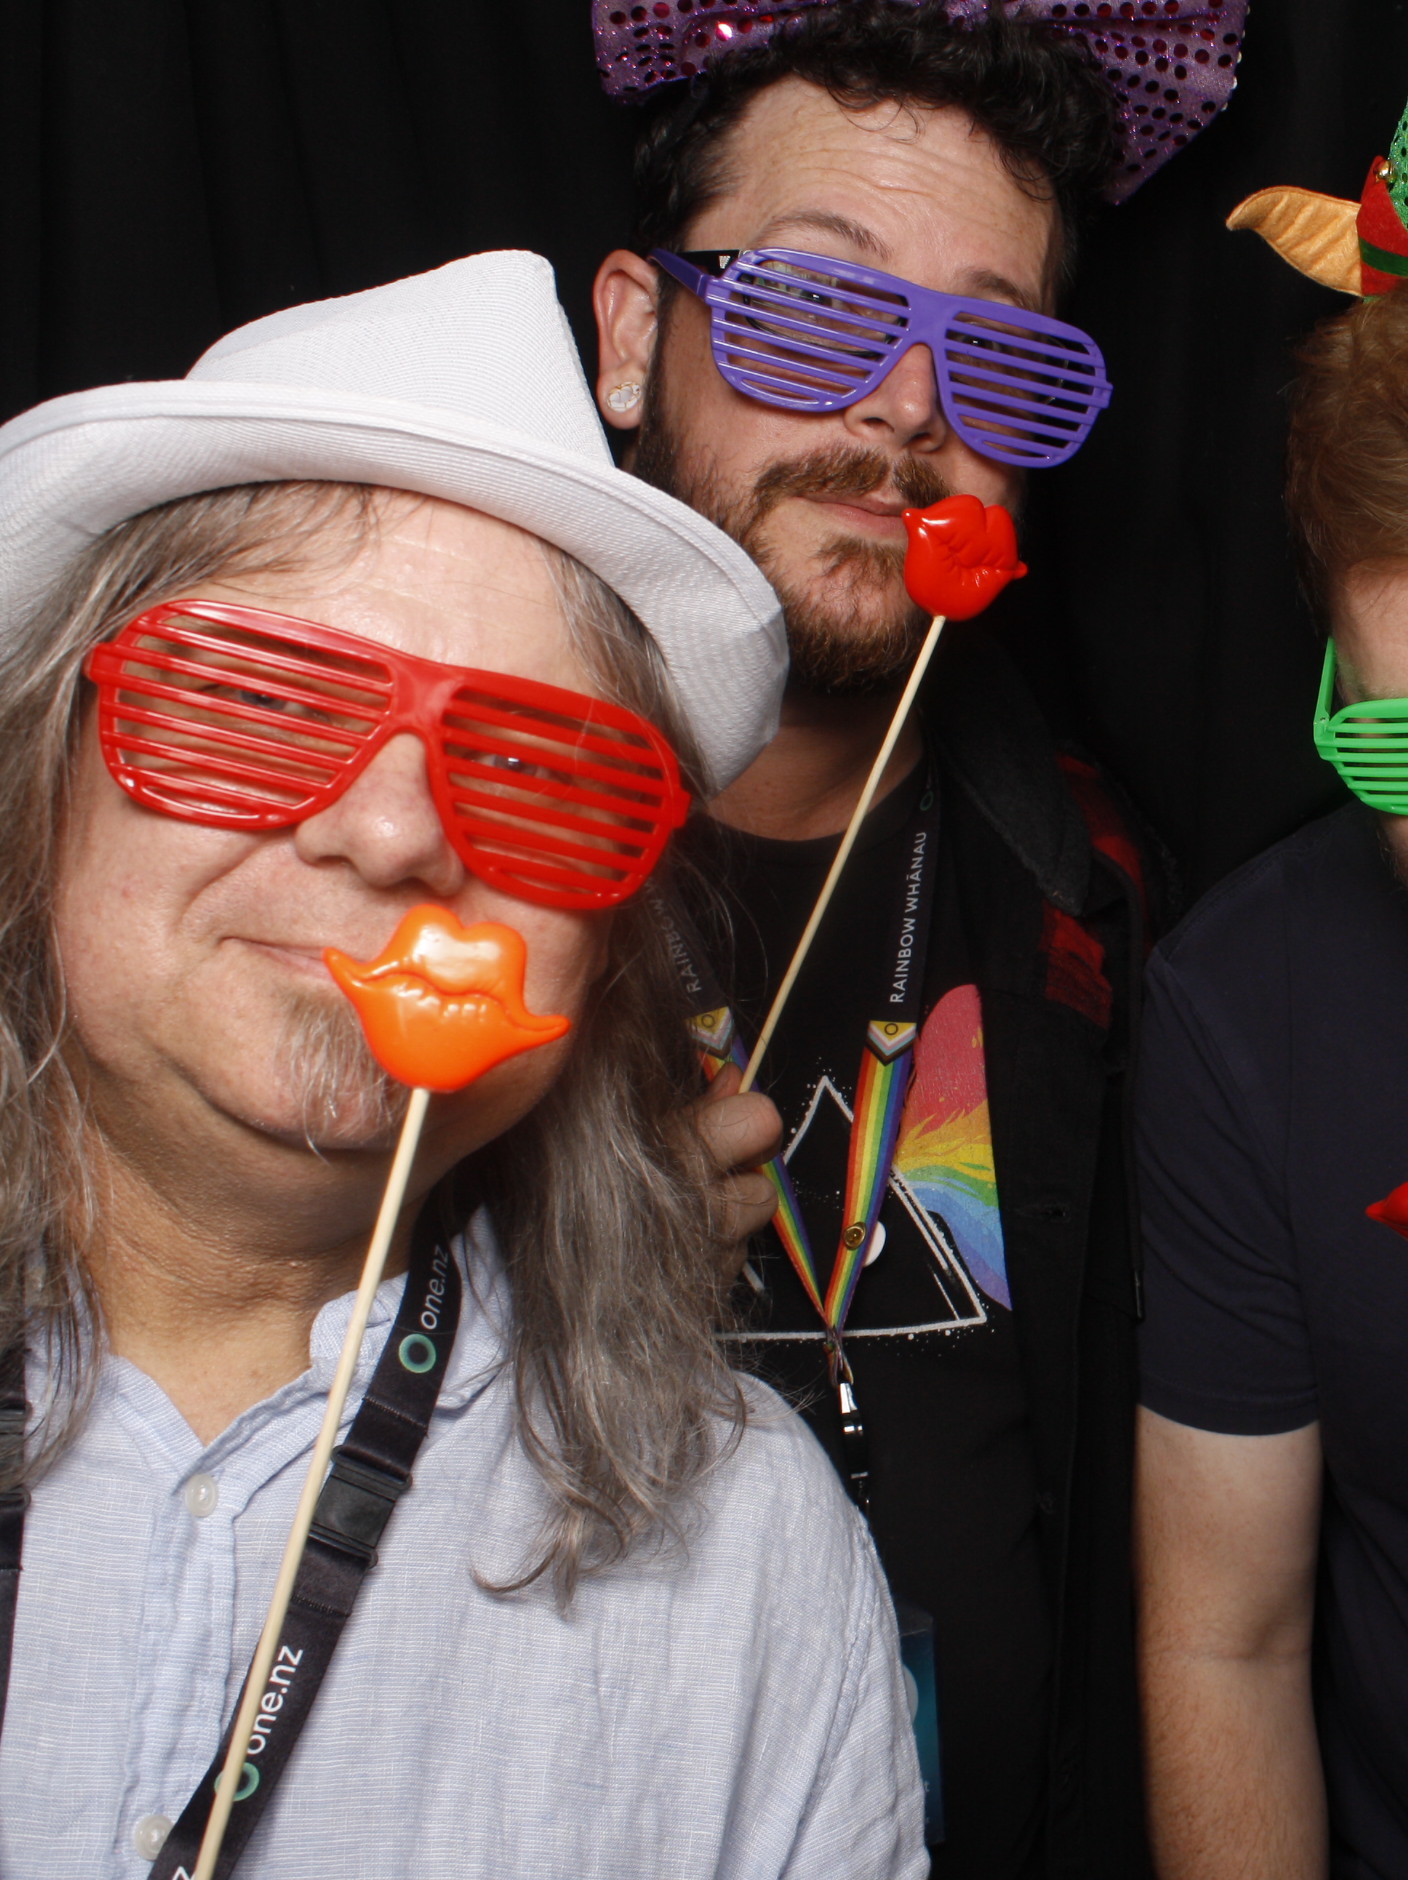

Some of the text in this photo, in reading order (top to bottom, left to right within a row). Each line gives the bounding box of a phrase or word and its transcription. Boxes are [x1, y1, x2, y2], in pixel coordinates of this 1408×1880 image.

[889, 831, 928, 1004] RAINBOW WHĀNAU
[420, 1244, 449, 1330] one.nz
[247, 1645, 304, 1755] one.nz
